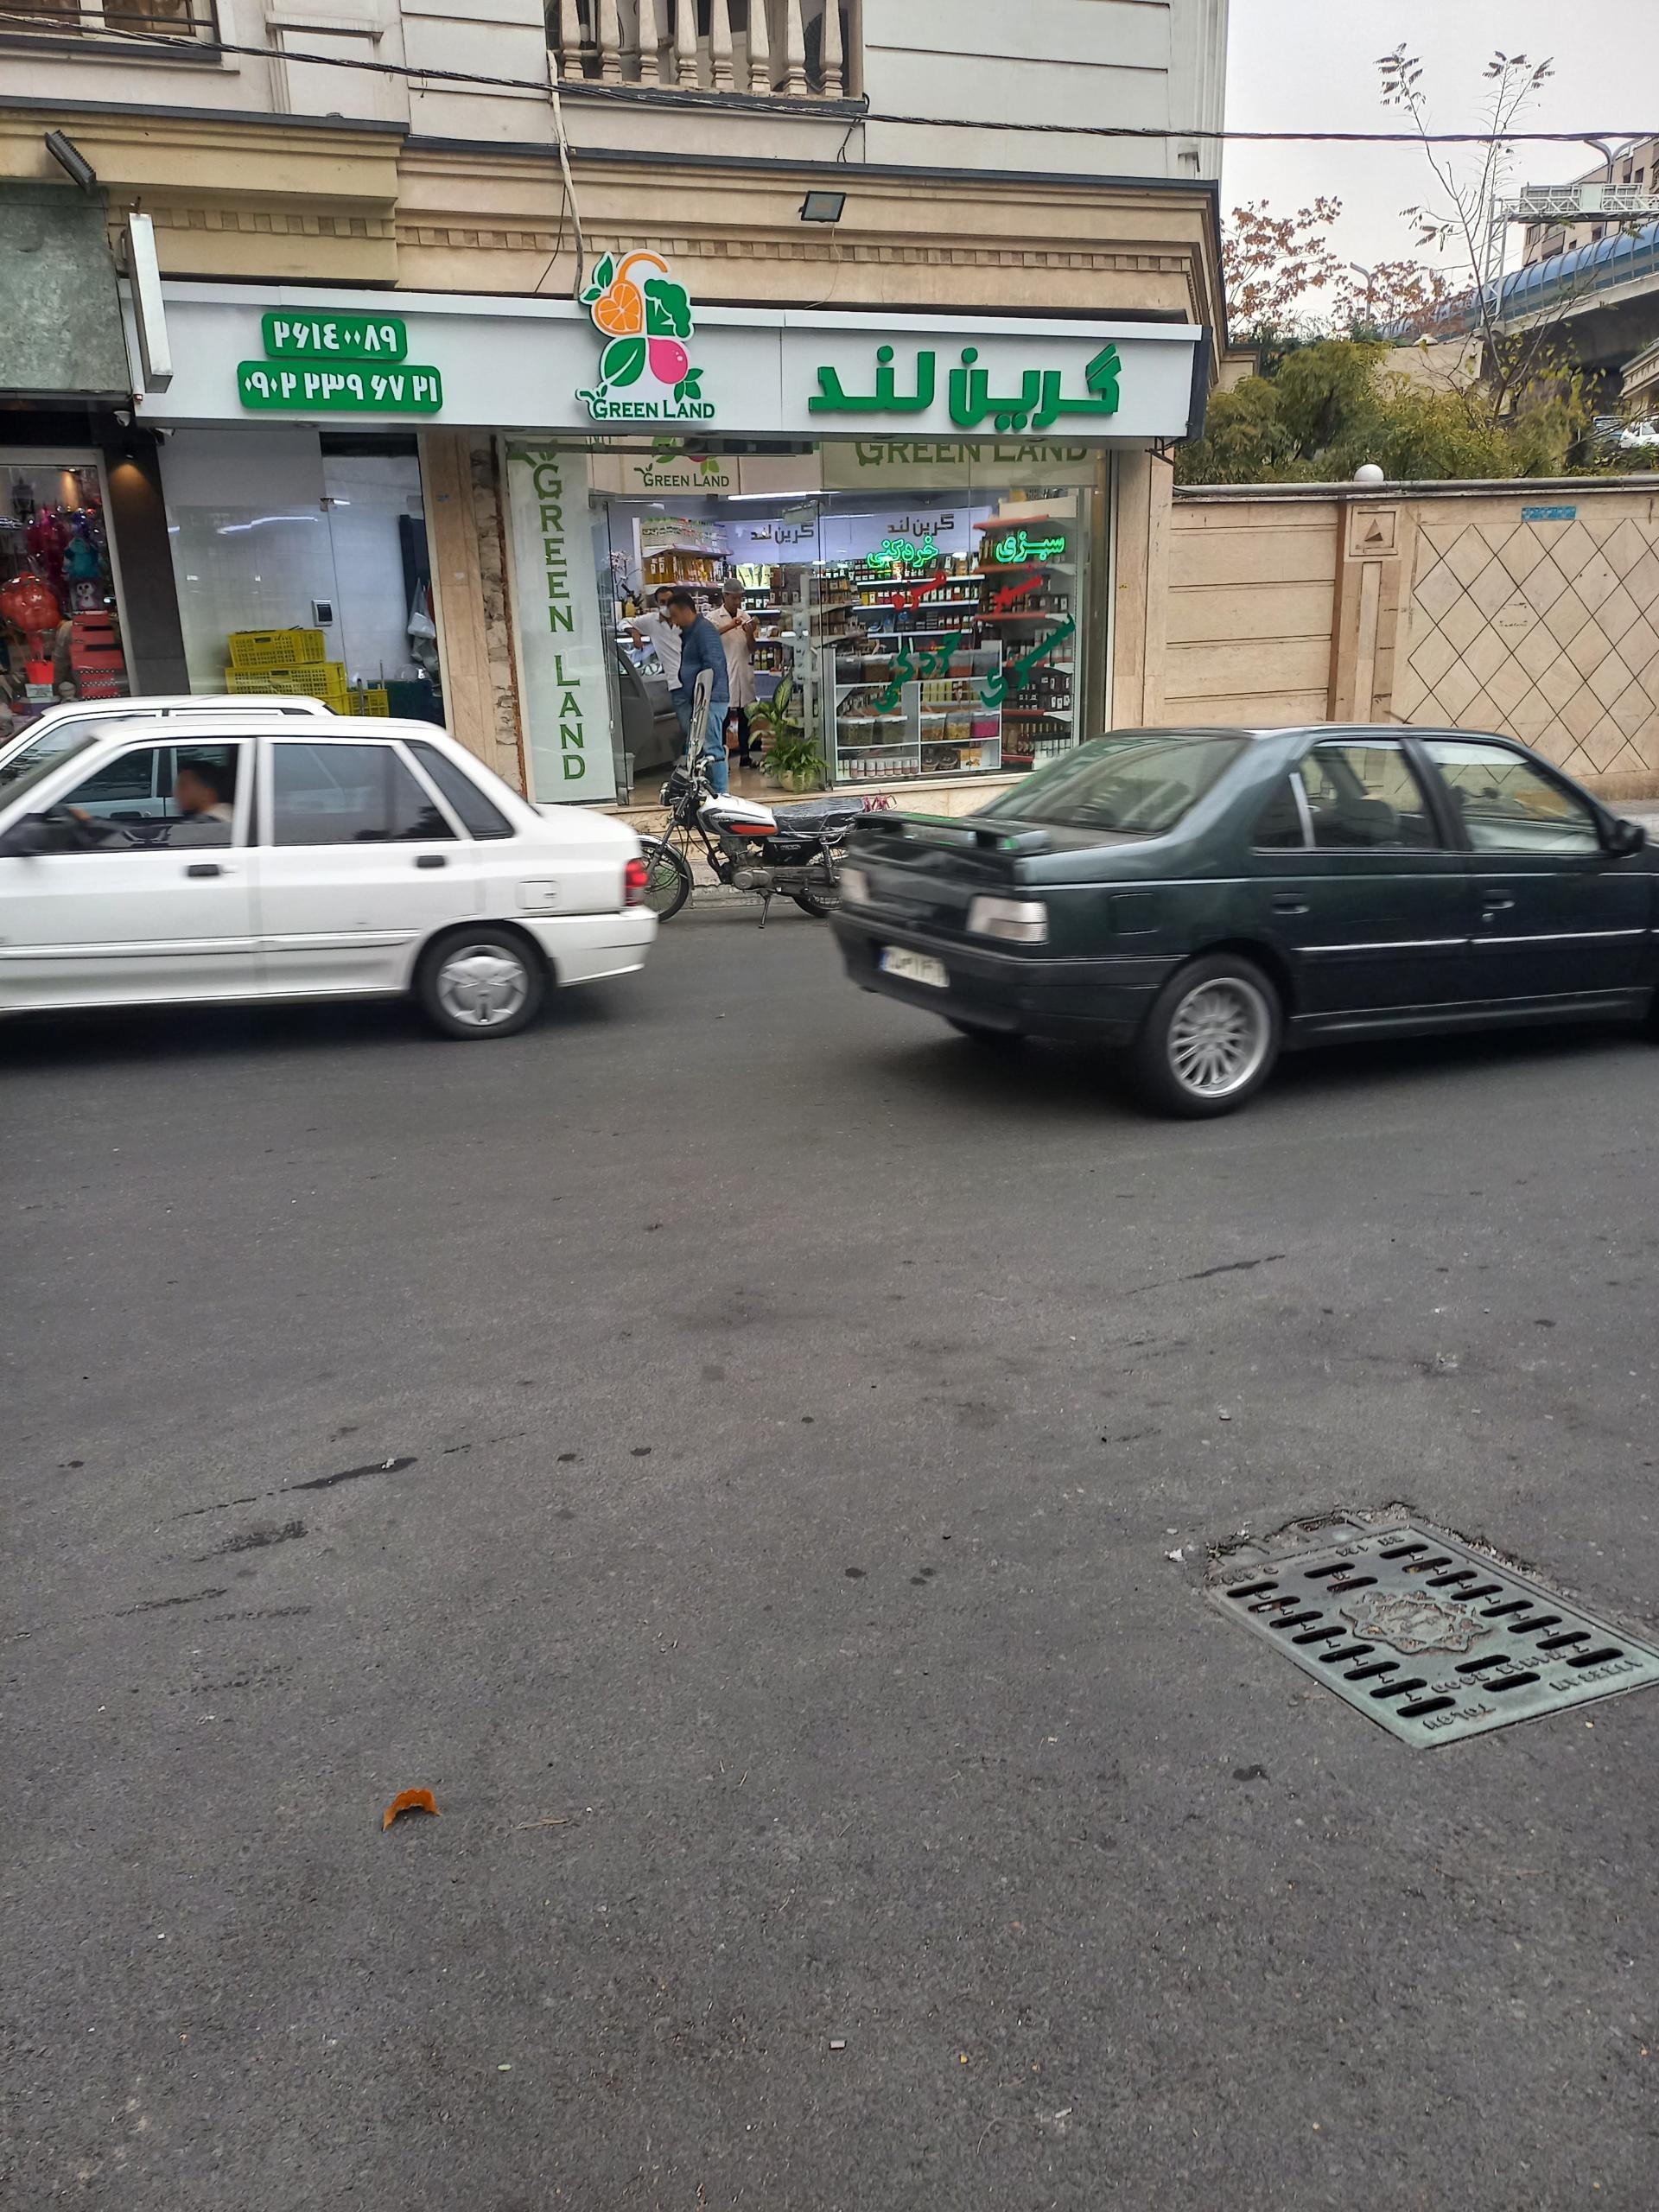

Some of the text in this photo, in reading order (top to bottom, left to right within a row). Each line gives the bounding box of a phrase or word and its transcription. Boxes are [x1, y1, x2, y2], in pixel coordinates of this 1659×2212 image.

[808, 342, 1122, 431] گرین لند
[593, 397, 715, 419] GREEN LAND
[643, 472, 729, 487] GREEN LAND
[995, 530, 1066, 563] سبزی
[533, 463, 587, 780] GREEN LAND
